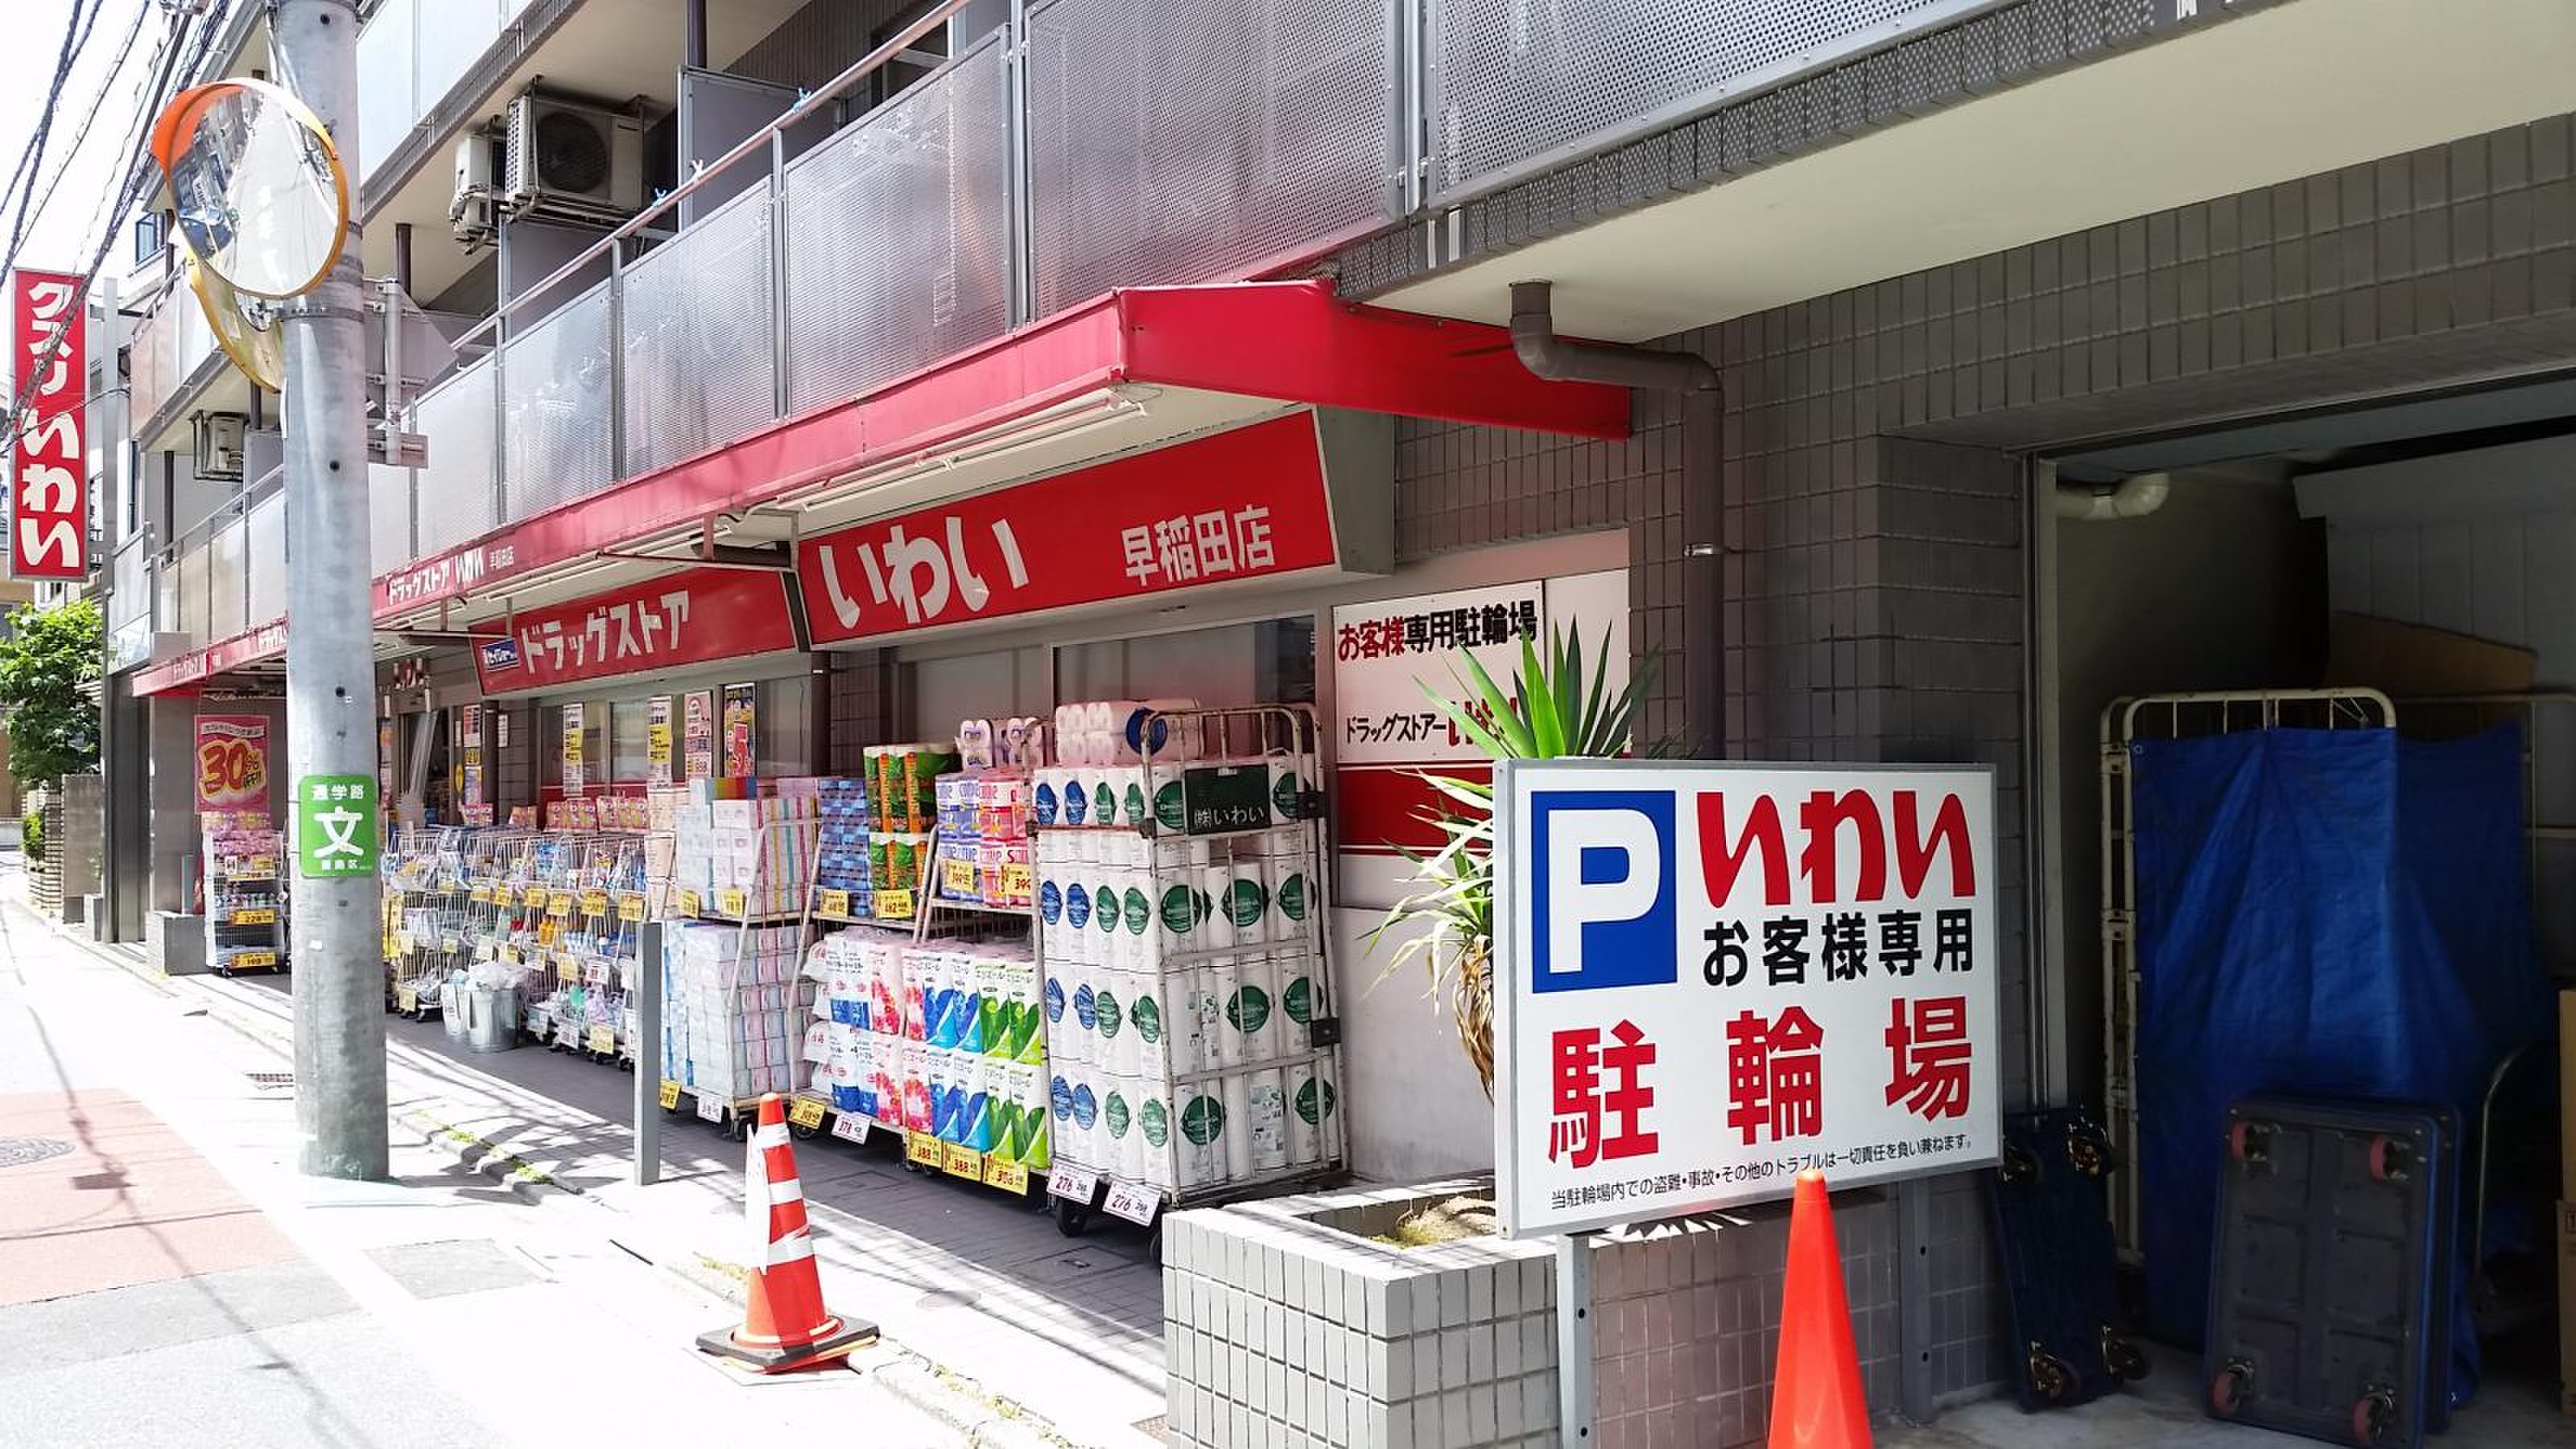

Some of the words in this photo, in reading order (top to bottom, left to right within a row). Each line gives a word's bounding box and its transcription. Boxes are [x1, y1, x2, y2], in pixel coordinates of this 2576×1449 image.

[390, 558, 452, 606] ドラッグストア
[819, 515, 1030, 630] いわい
[1121, 505, 1276, 587] 早稲田店
[521, 591, 690, 675] ドラッグストア
[1339, 600, 1538, 662] お客様専用駐輪場
[313, 805, 365, 858] 文
[1696, 788, 1976, 908] いわい
[1547, 808, 1661, 975] P
[1702, 907, 1973, 989] お客様専用
[1547, 995, 1972, 1170] 駐輪場
[1055, 1174, 1074, 1193] 276
[1112, 1194, 1132, 1212] 276
